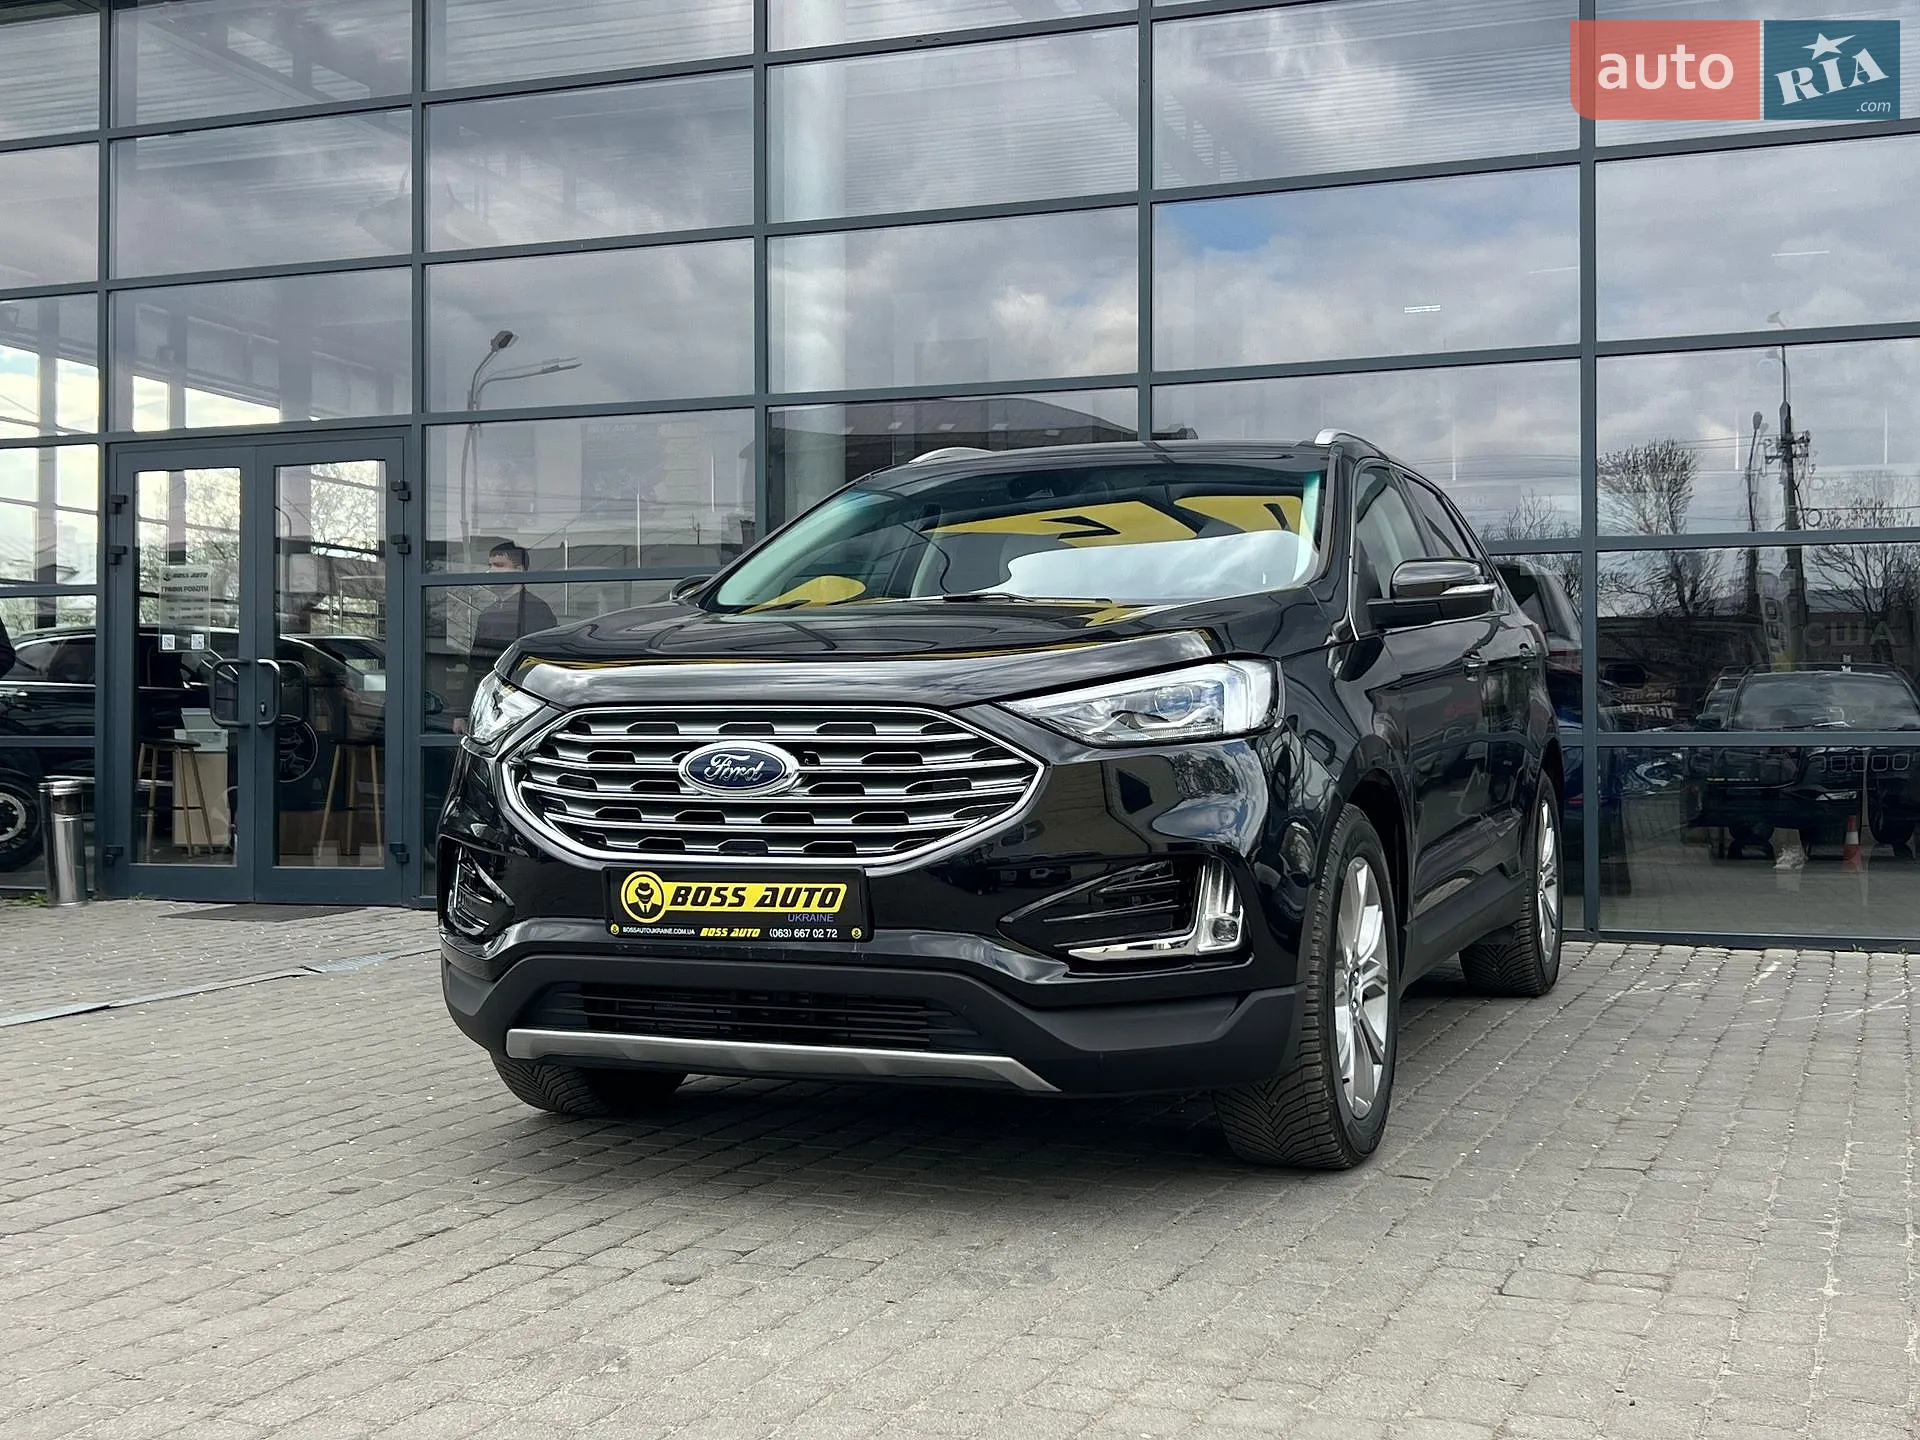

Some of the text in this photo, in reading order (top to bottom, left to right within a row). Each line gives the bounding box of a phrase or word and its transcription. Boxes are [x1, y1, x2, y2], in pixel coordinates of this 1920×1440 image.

[703, 753, 765, 781] Ford
[670, 886, 841, 908] BOSS AUTO
[787, 913, 834, 922] UKRAINE
[700, 928, 761, 938] BOSS AUTO
[769, 928, 838, 938] (063) 667 02 72
